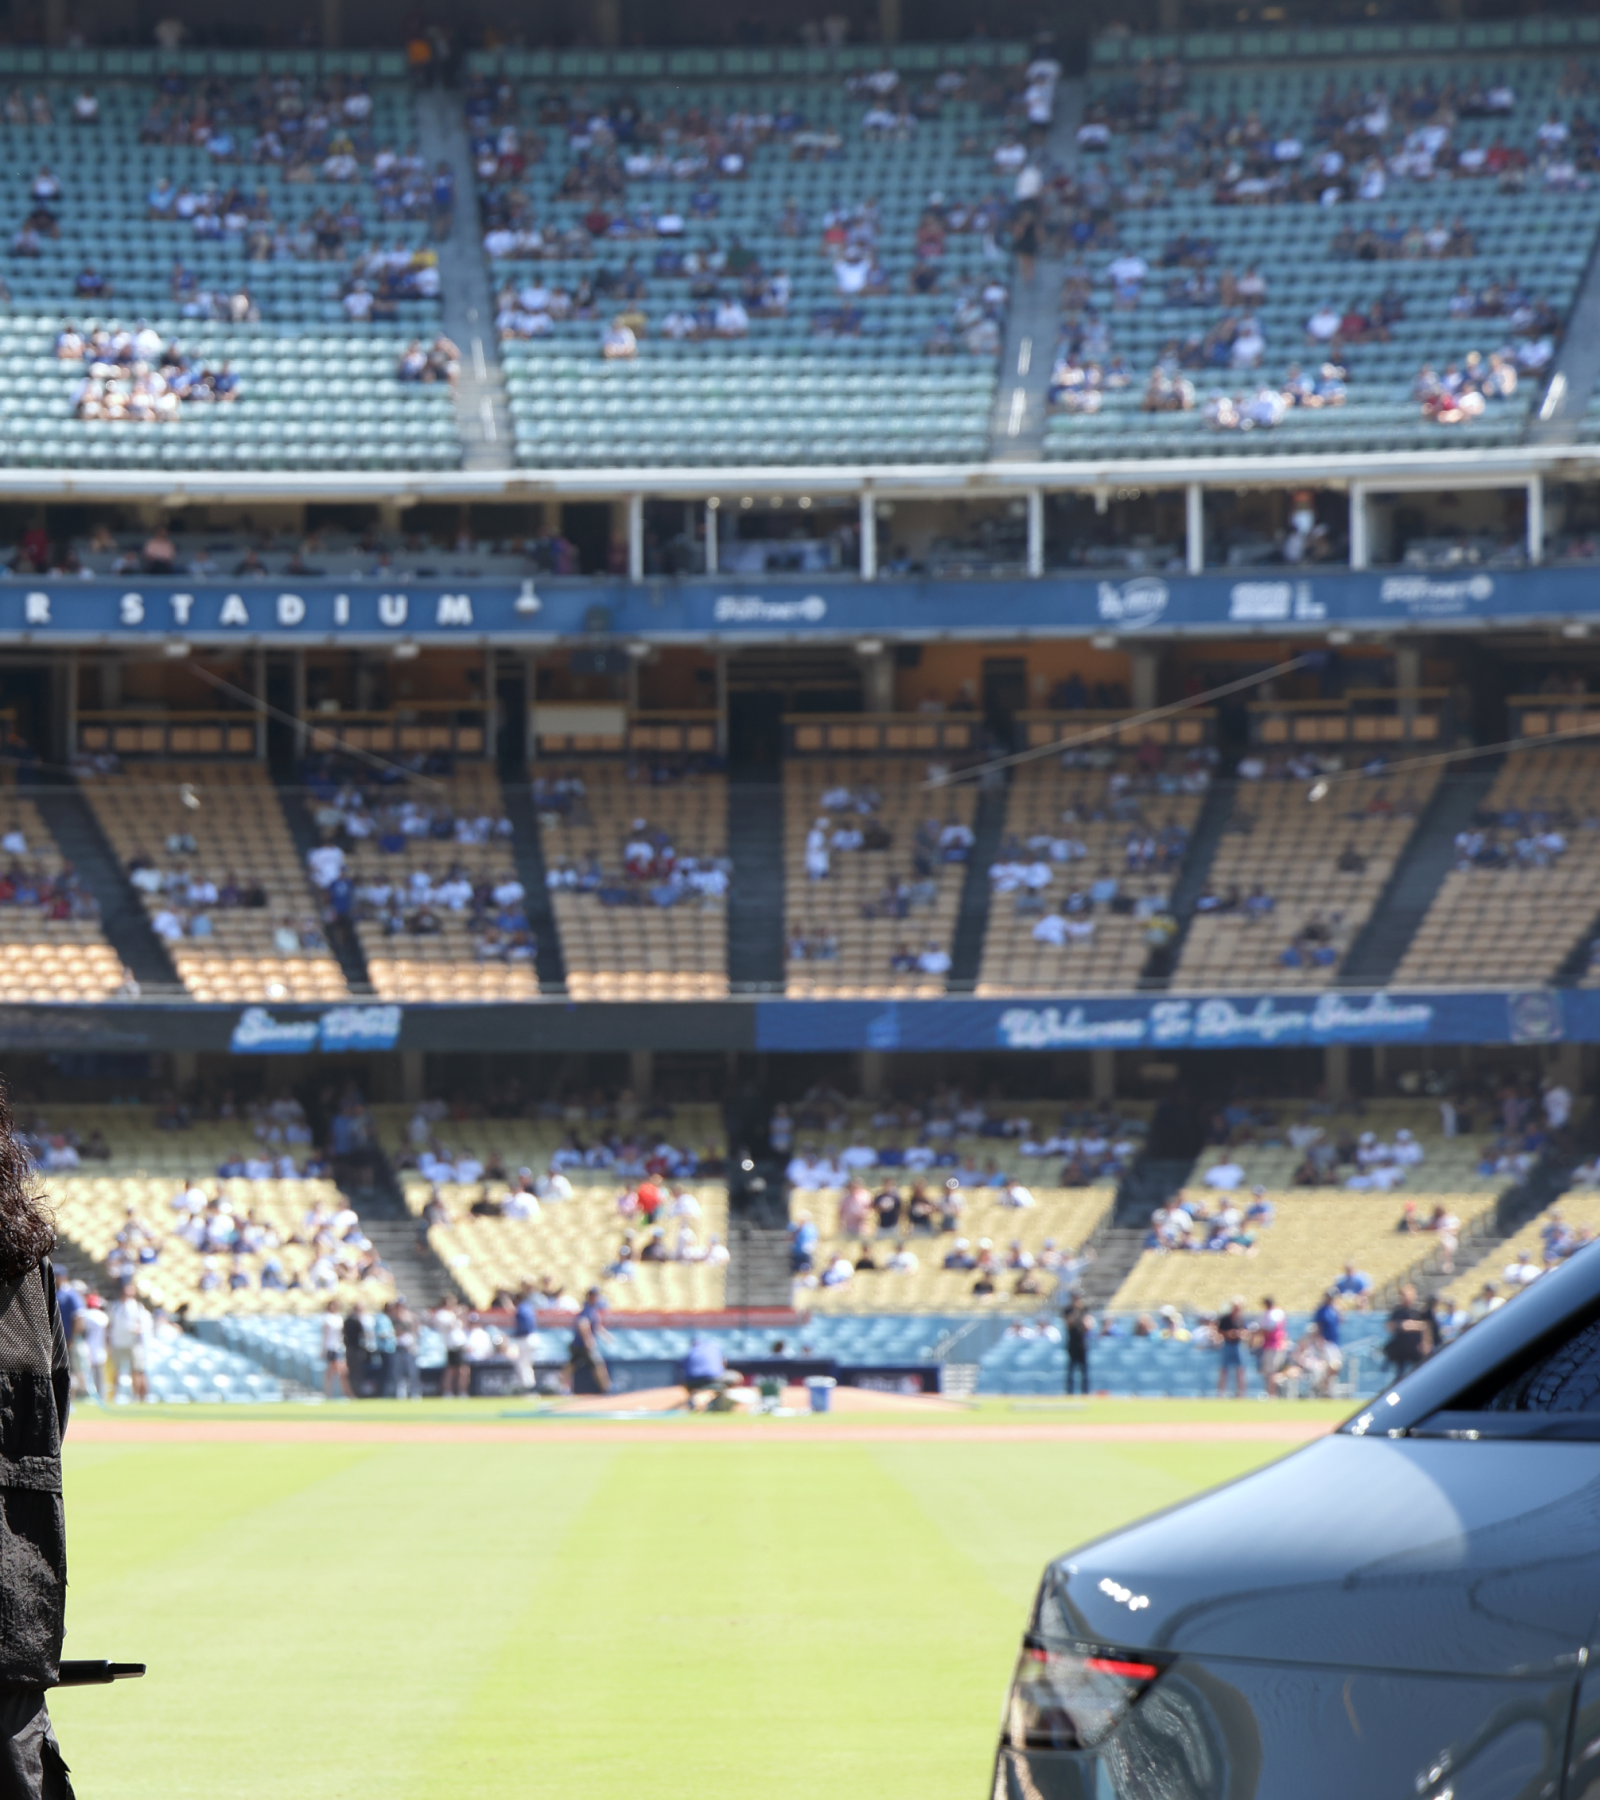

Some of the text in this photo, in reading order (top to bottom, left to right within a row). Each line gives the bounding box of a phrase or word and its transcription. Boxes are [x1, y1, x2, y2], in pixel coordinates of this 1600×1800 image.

[121, 593, 473, 625] STADIUM
[234, 1007, 319, 1046] Since
[1000, 1007, 1146, 1049] Welcome
[1311, 992, 1433, 1032] Stadium
